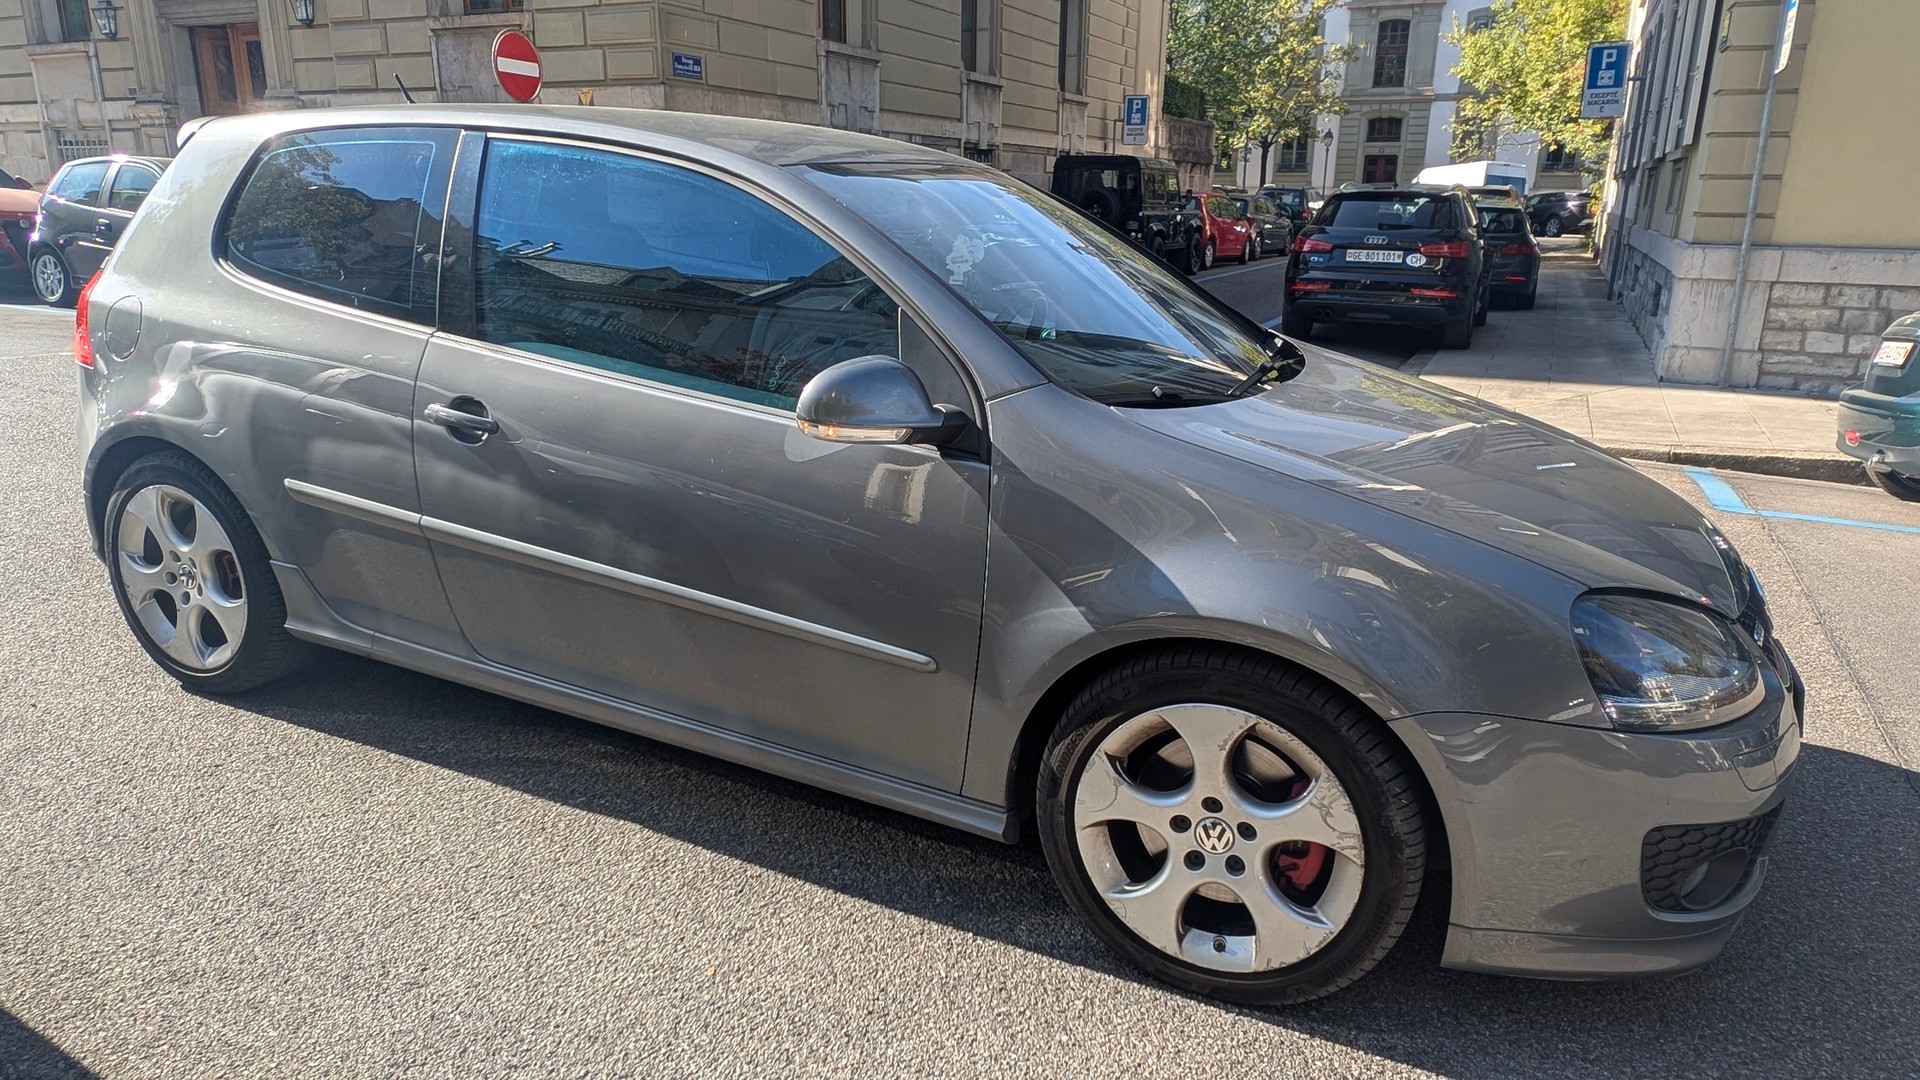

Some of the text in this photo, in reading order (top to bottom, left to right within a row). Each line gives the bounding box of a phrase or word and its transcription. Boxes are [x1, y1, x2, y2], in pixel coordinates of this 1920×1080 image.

[1601, 49, 1617, 69] P
[1133, 100, 1141, 113] P
[1411, 256, 1421, 264] CH
